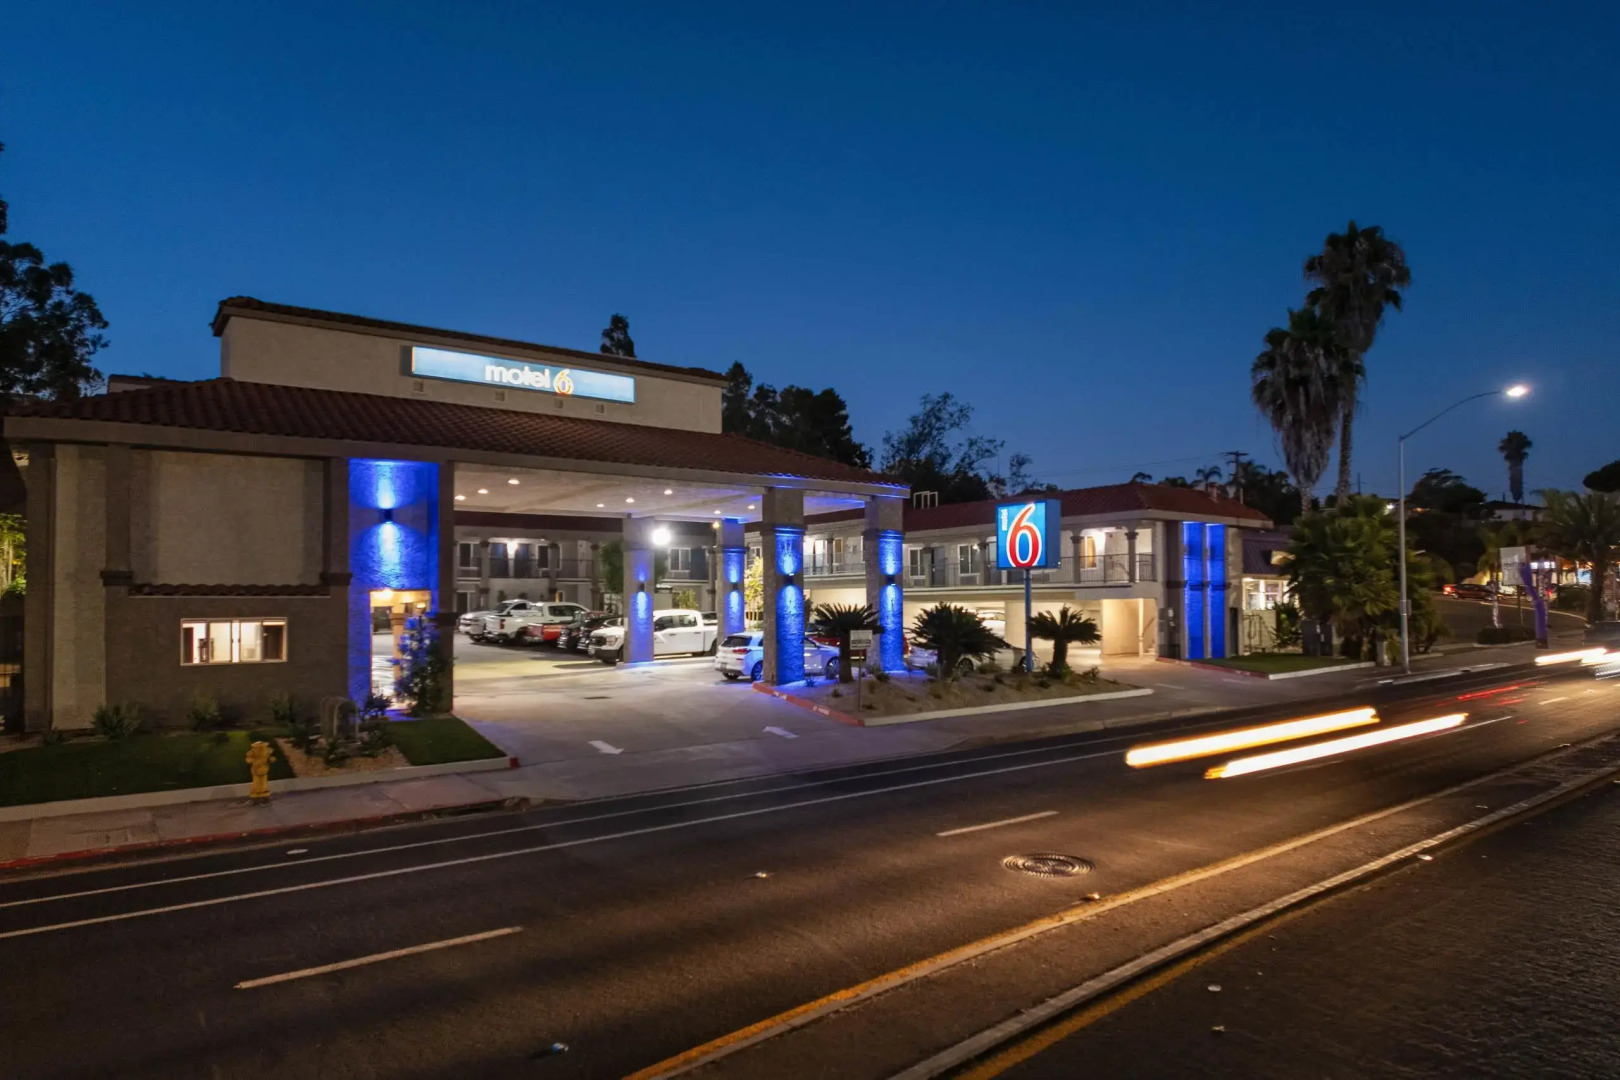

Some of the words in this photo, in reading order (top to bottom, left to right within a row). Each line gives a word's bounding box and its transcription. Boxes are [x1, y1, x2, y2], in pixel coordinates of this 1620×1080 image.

[485, 365, 551, 389] motel
[553, 368, 574, 395] 6
[1006, 503, 1042, 567] 6
